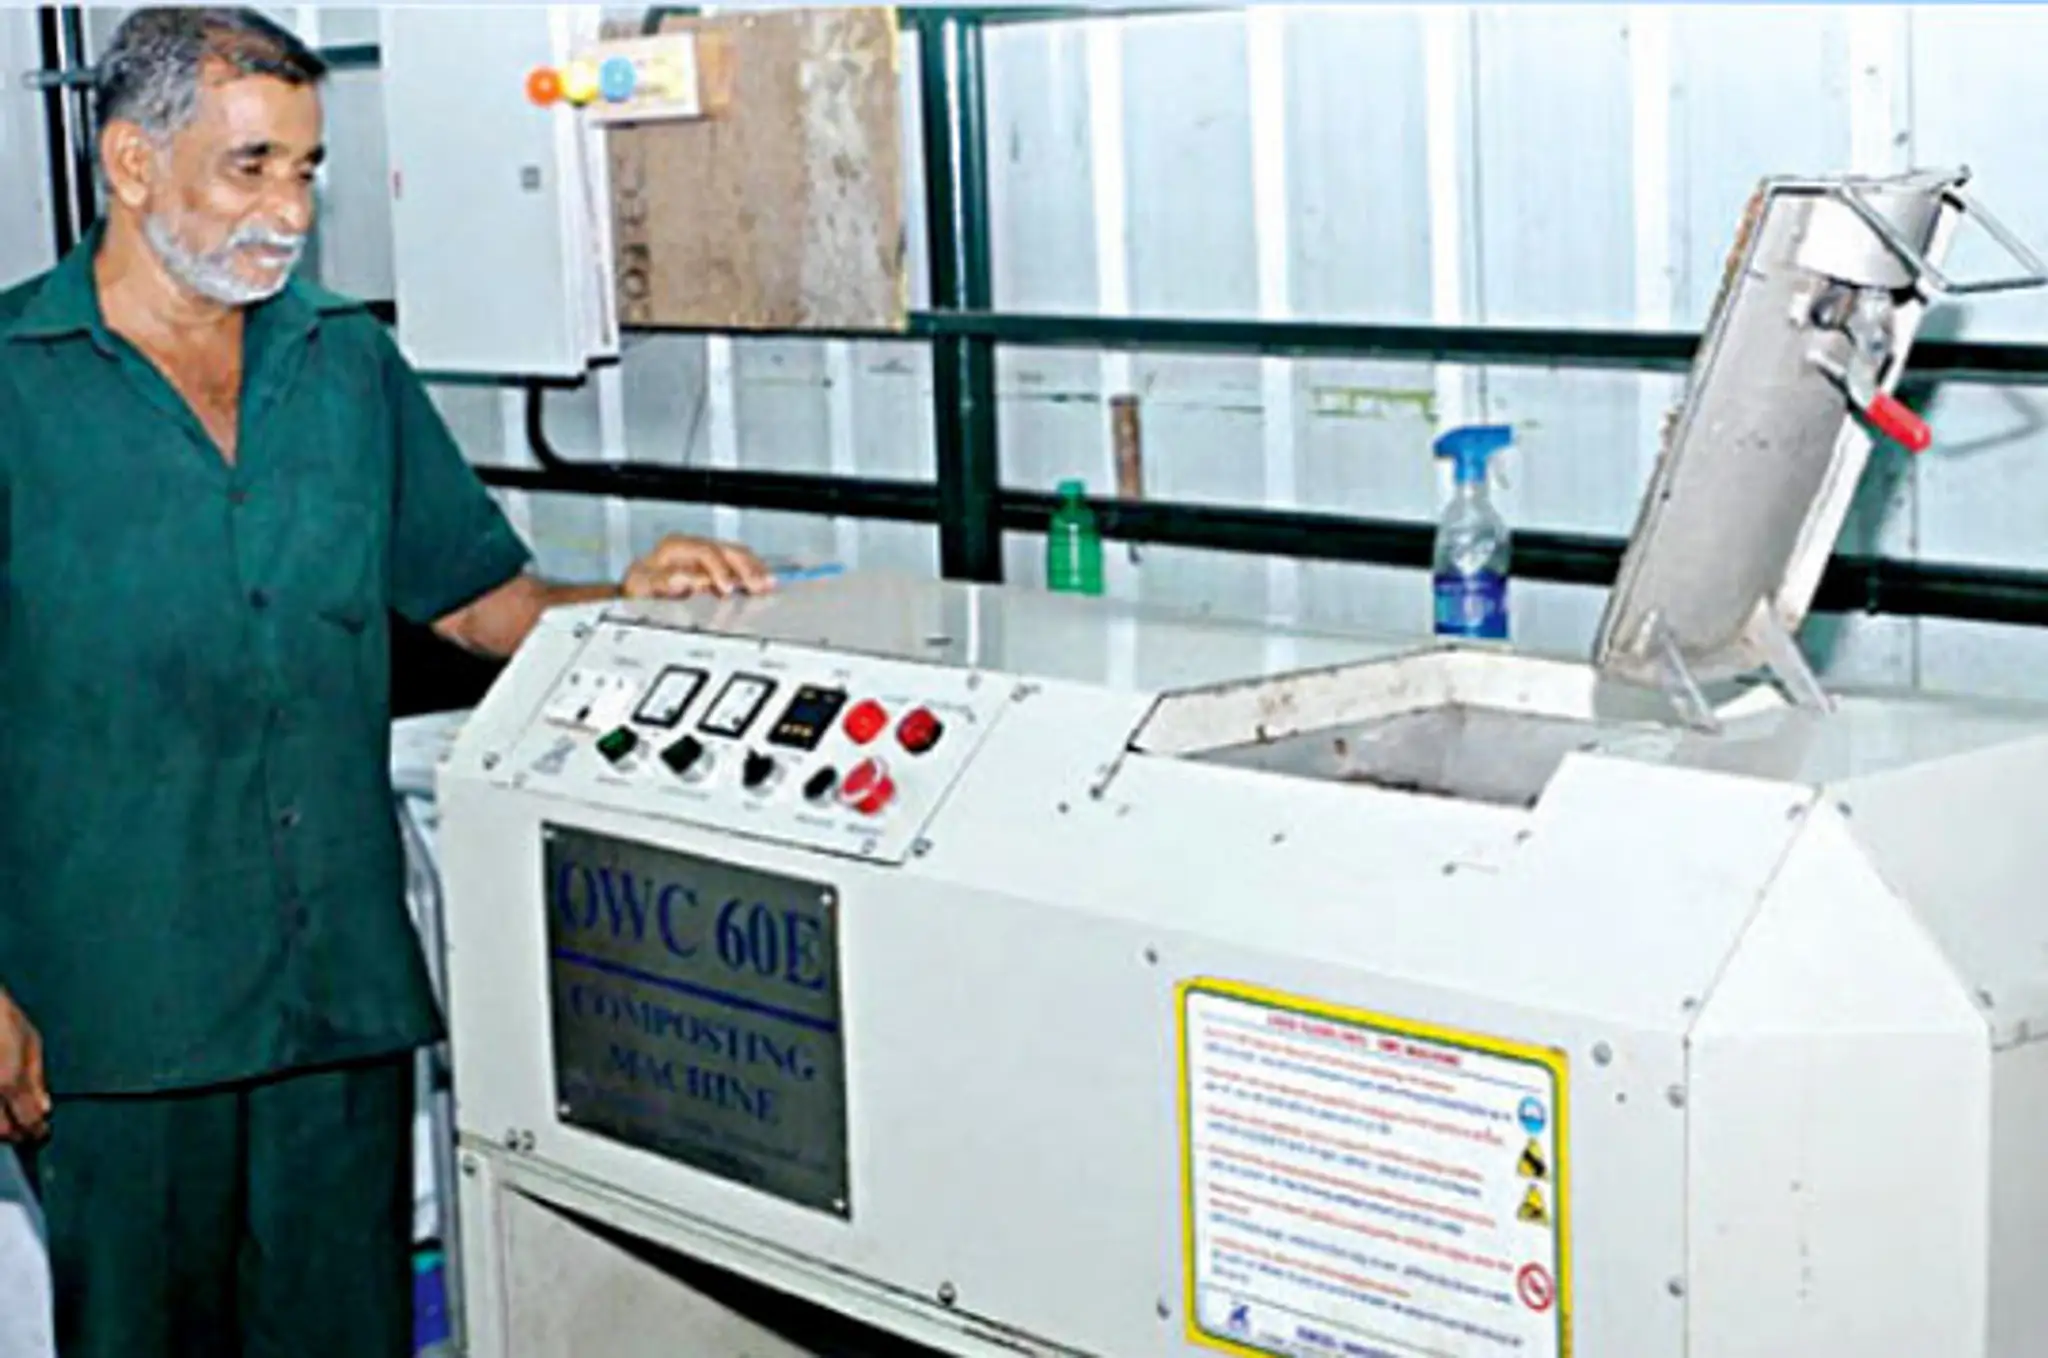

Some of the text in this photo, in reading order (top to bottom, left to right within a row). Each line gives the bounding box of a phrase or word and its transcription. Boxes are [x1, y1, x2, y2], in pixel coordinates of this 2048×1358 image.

[556, 859, 826, 991] OWC 60E
[569, 982, 818, 1082] COMPOSTING
[608, 1041, 782, 1126] MACHINE
